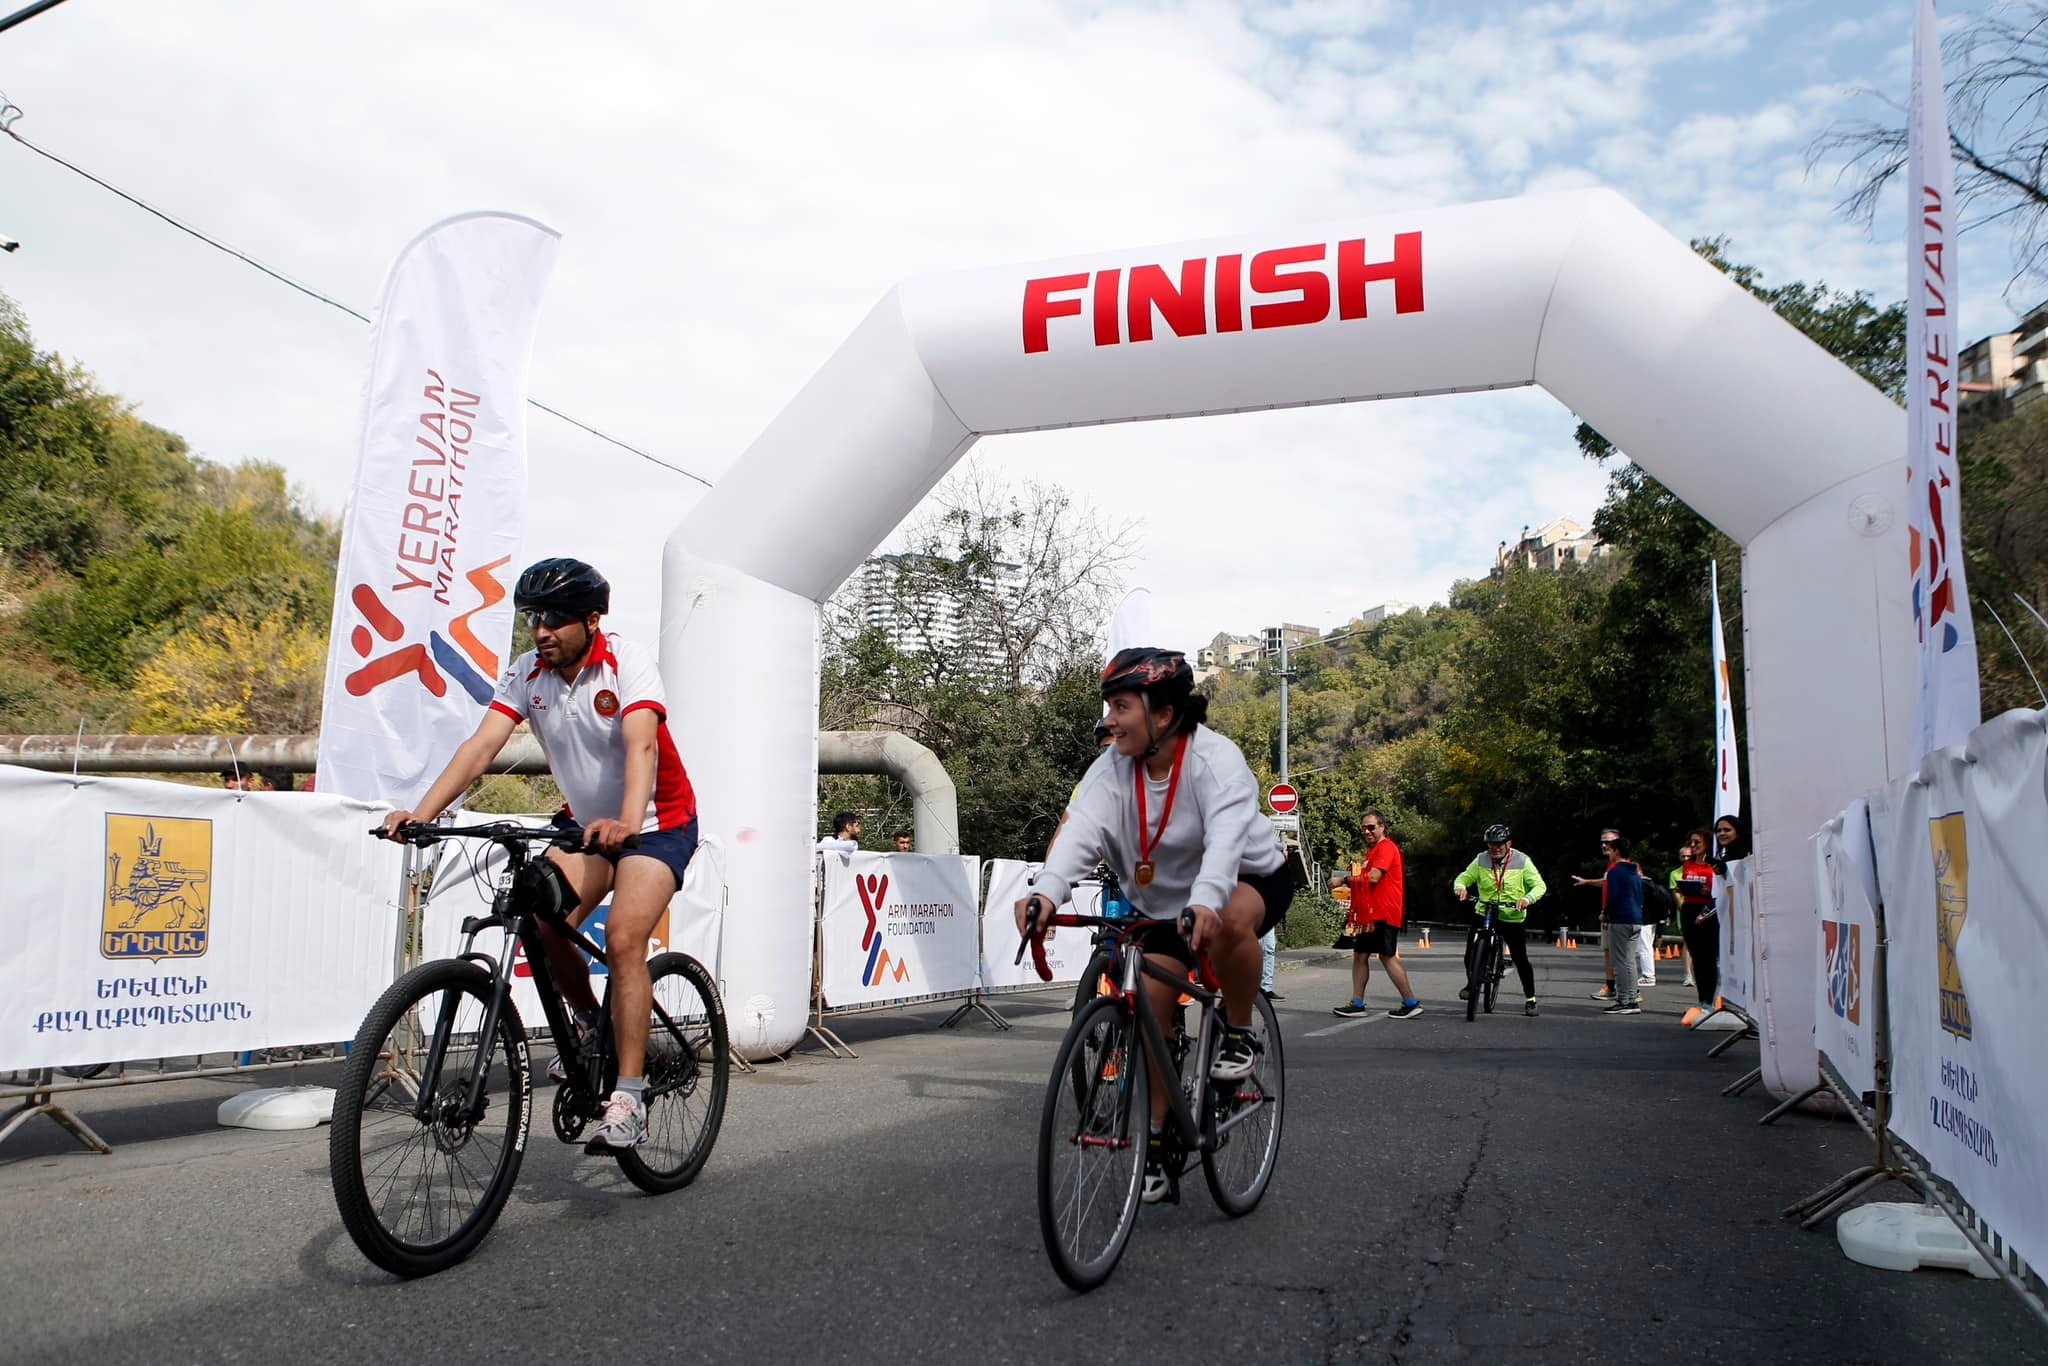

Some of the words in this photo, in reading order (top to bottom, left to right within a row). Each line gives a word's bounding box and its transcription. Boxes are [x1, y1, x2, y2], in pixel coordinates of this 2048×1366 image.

[1022, 231, 1425, 354] FINISH
[391, 368, 449, 592] YEREVAN
[433, 387, 481, 606] MARATHON
[888, 904, 908, 919] ARM
[910, 903, 954, 918] MARATHON
[887, 921, 935, 936] FOUNDATION
[97, 975, 208, 999] ԵՐԵՎԱՆԻ
[517, 1041, 529, 1069] CST
[521, 1070, 531, 1093] ALL
[515, 1094, 531, 1153] TERRAINS
